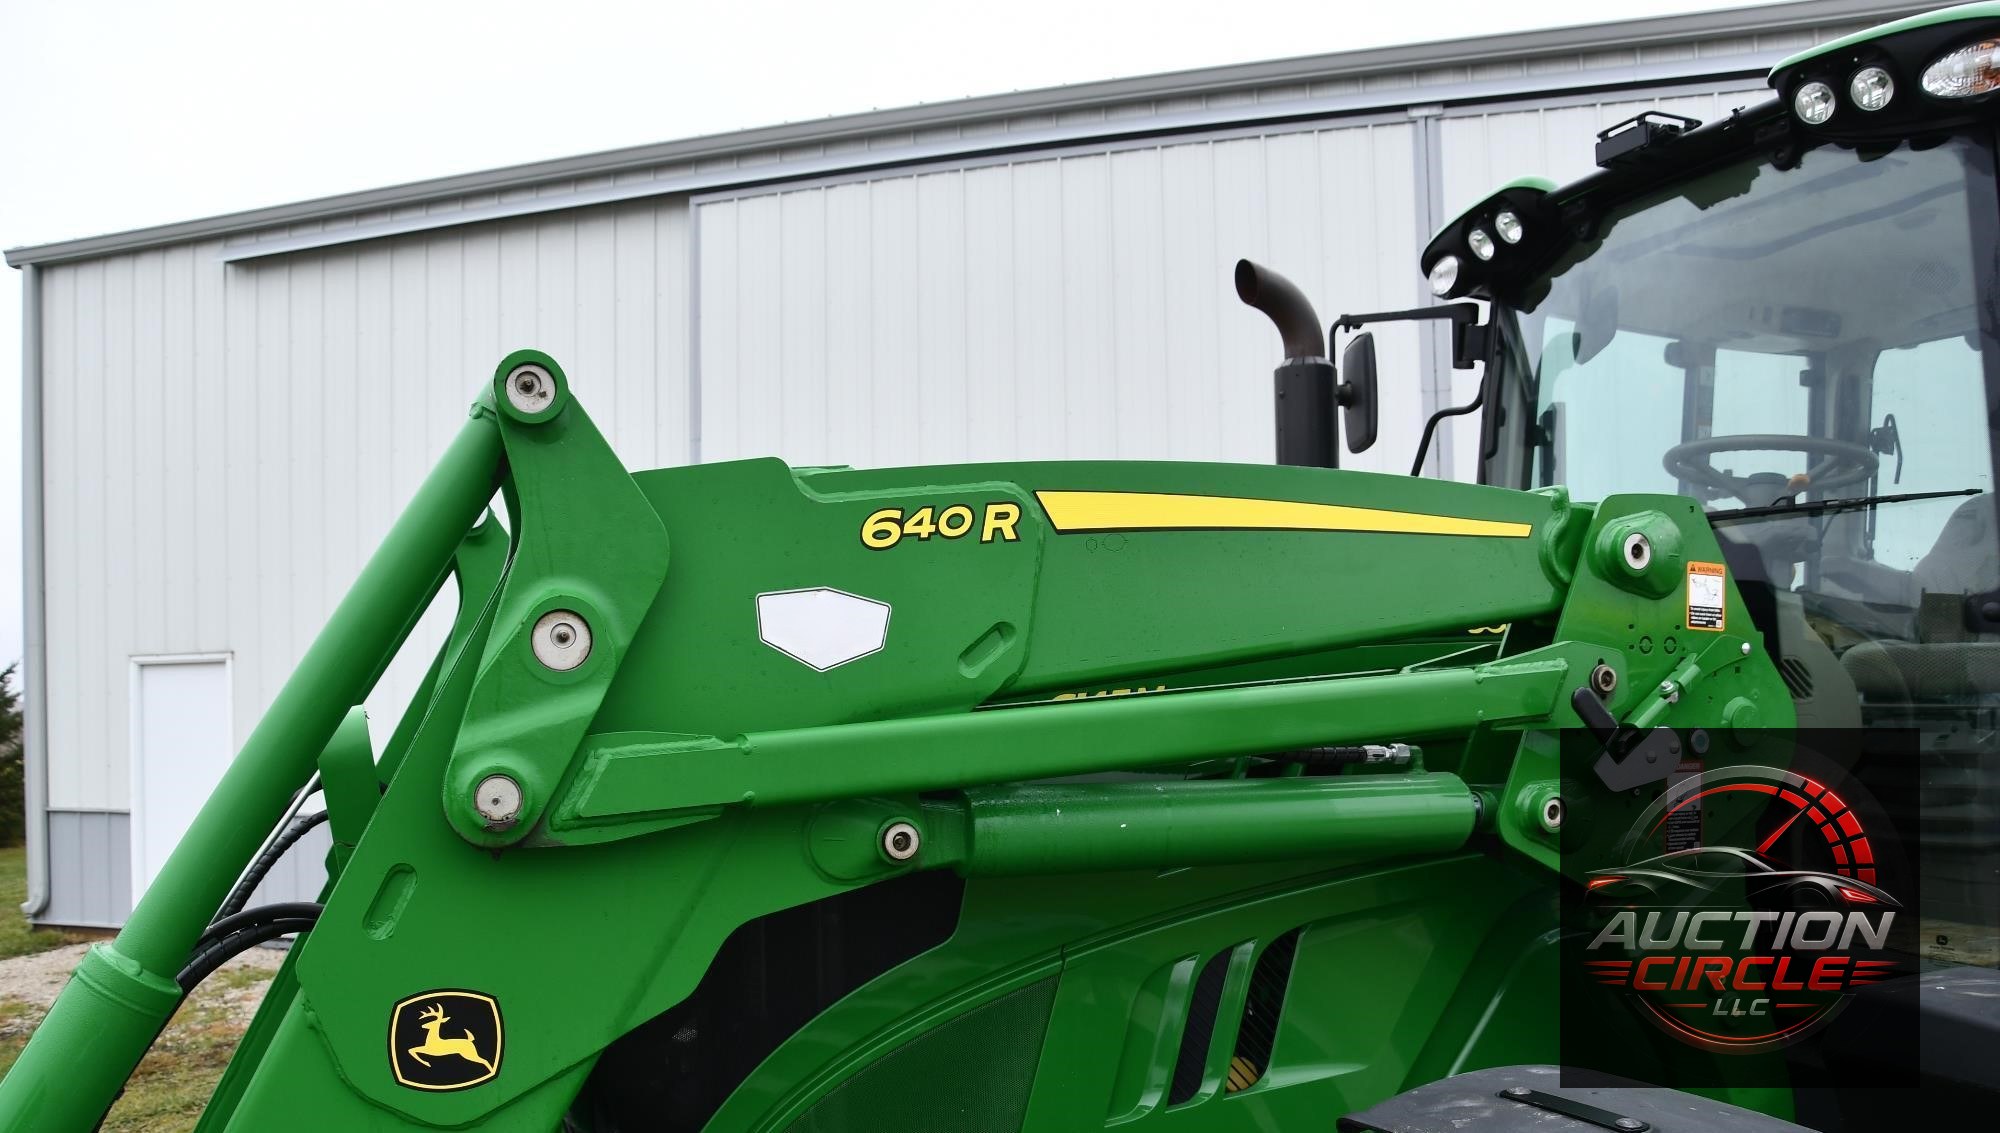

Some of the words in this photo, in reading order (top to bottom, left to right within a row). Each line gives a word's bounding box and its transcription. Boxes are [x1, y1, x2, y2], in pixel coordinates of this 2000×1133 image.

[860, 503, 975, 551] 640
[980, 501, 1022, 543] R
[1697, 566, 1723, 575] WARNING
